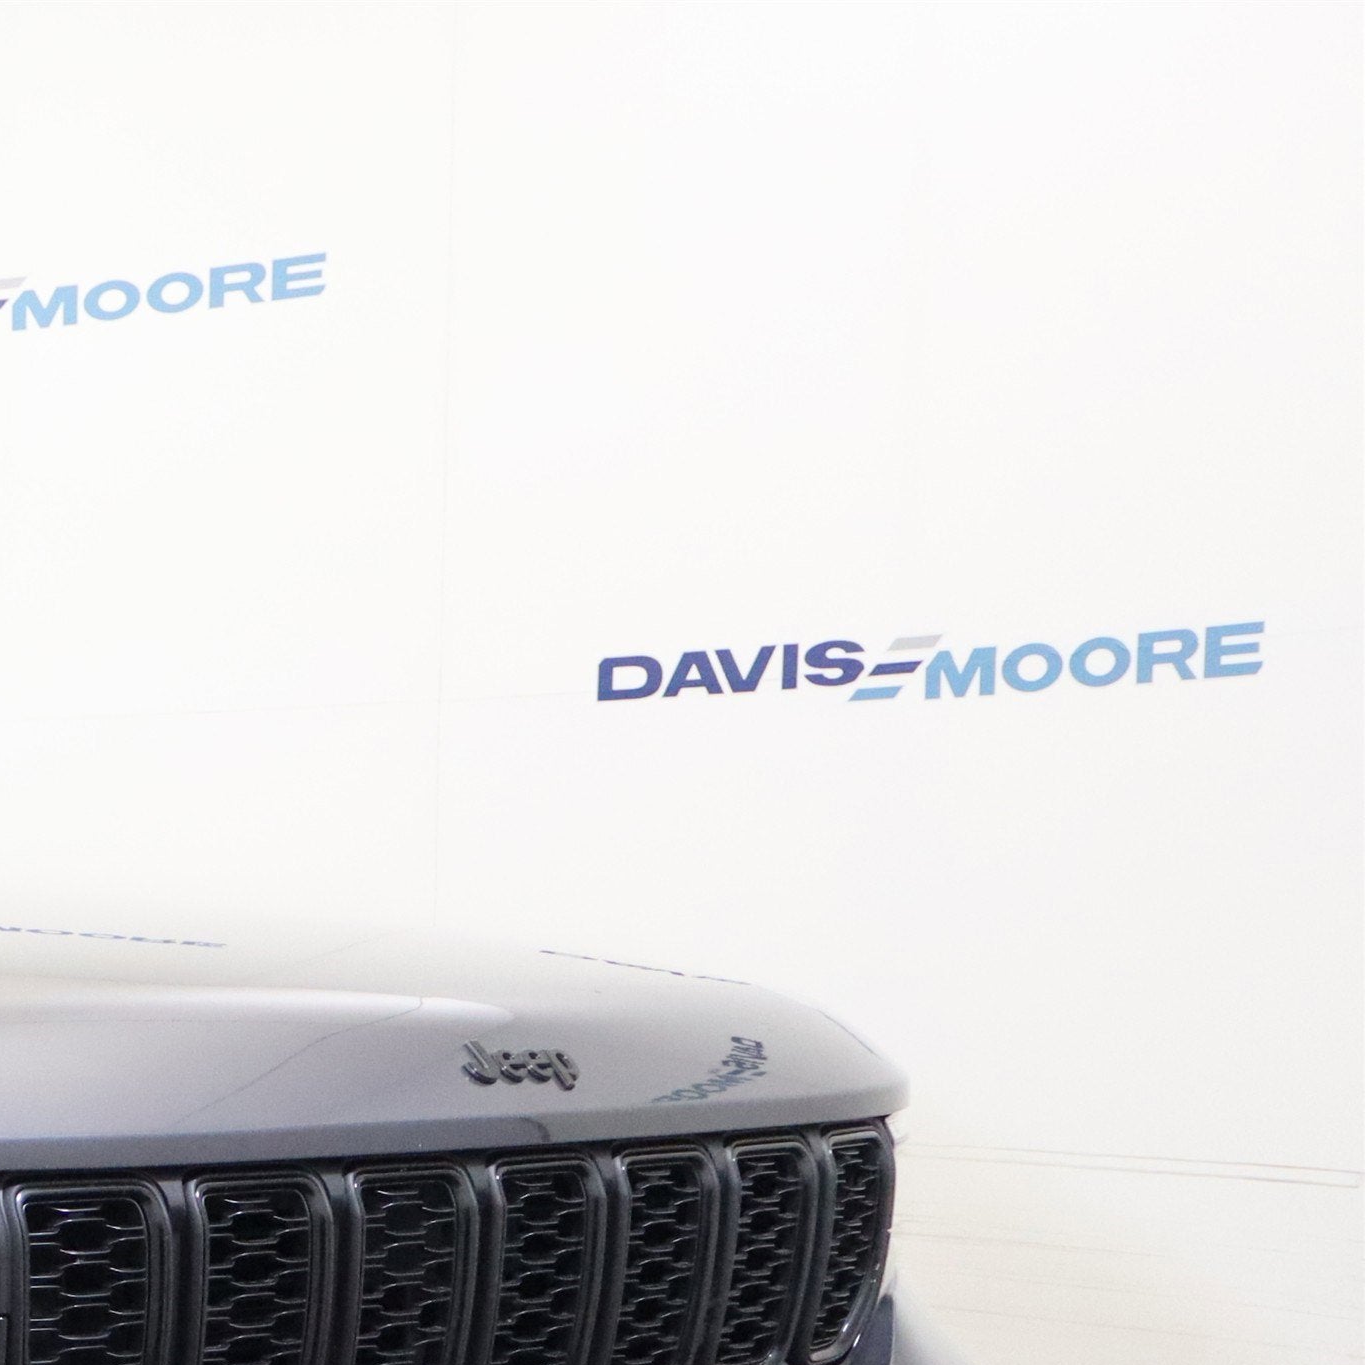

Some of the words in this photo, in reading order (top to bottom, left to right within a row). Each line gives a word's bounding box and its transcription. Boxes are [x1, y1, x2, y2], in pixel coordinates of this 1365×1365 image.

[11, 252, 326, 332] MOORE
[596, 638, 865, 701] DAVIS
[924, 619, 1266, 700] MOORE
[460, 1038, 581, 1092] Jeep
